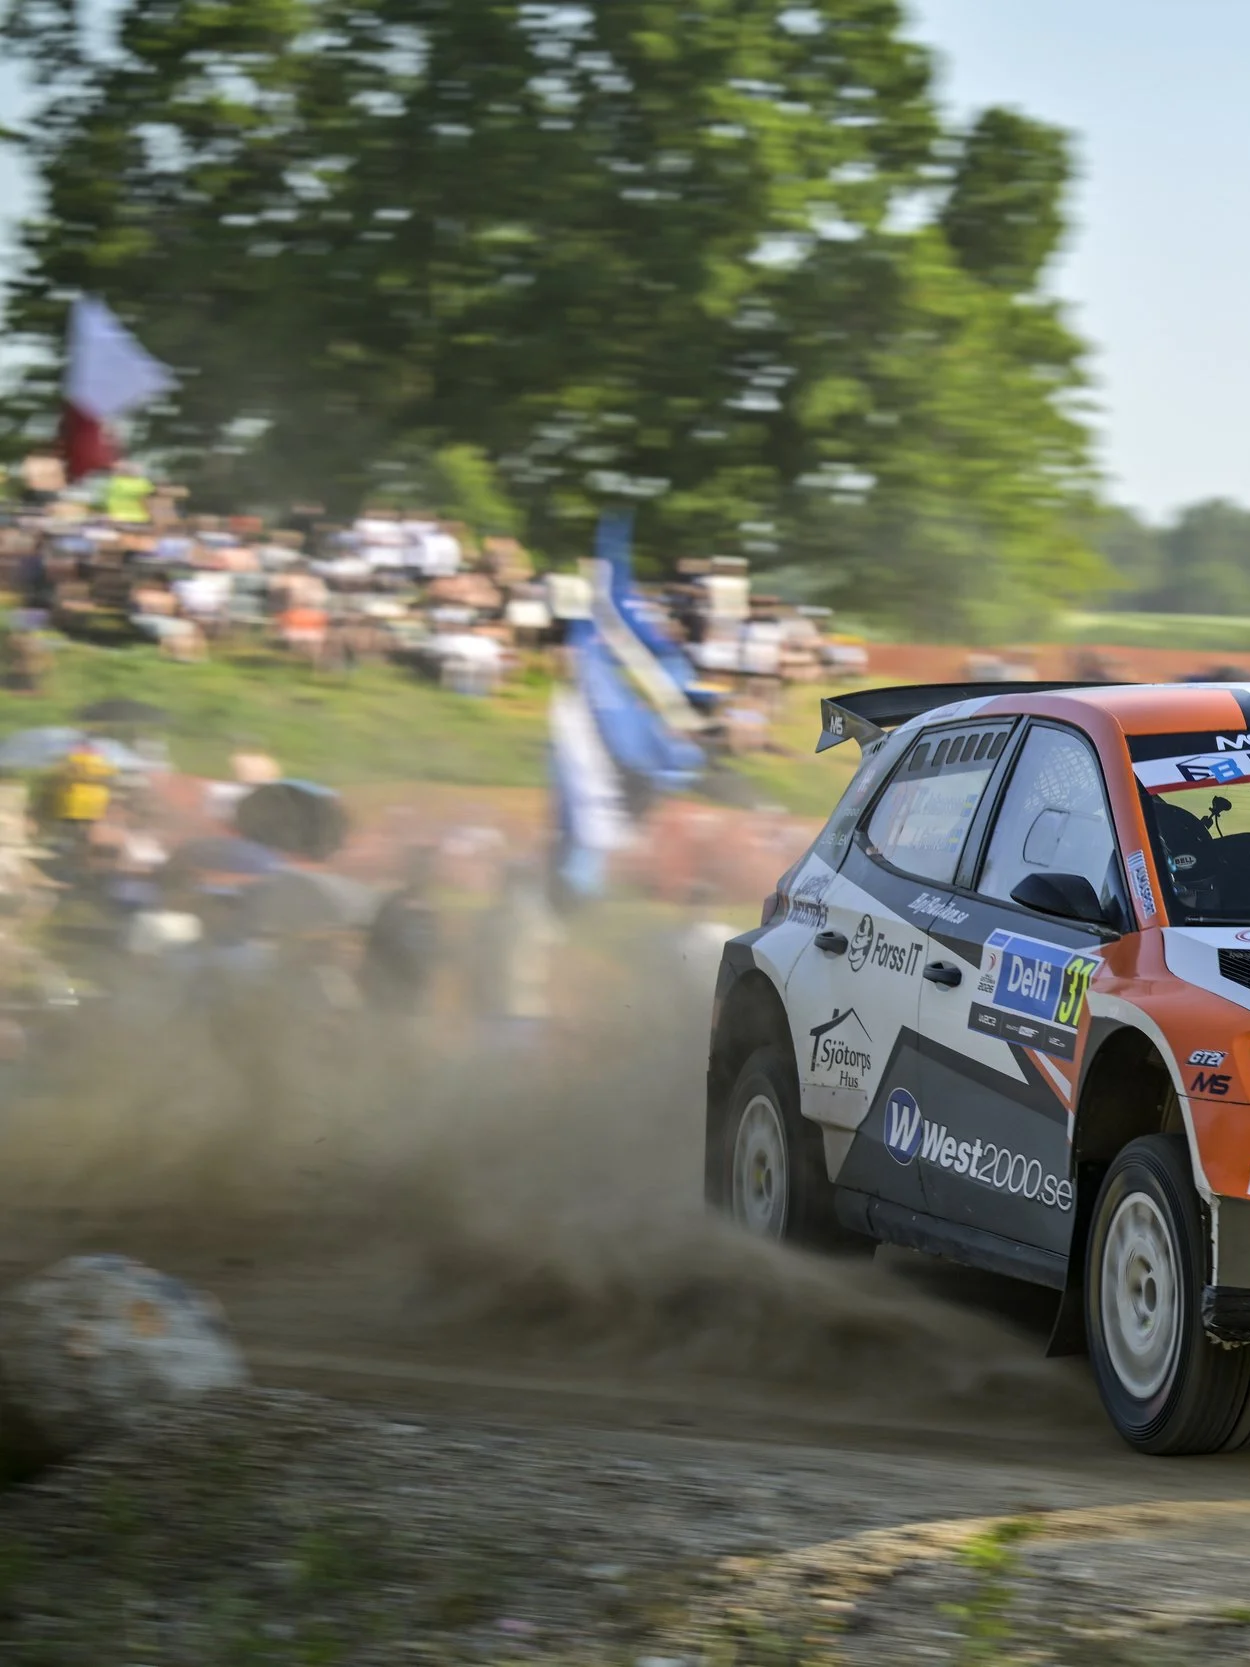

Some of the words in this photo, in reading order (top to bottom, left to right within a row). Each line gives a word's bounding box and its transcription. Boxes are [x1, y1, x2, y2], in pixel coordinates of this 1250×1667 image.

[1175, 855, 1194, 865] BELL
[870, 933, 906, 972] Forss
[904, 942, 923, 976] IT
[1007, 955, 1053, 1002] Delfi
[1058, 957, 1097, 1027] 31
[820, 1036, 873, 1076] Sjötorps
[839, 1069, 859, 1089] Hus
[1190, 1072, 1233, 1096] MS
[922, 1118, 1074, 1212] West2000.se
